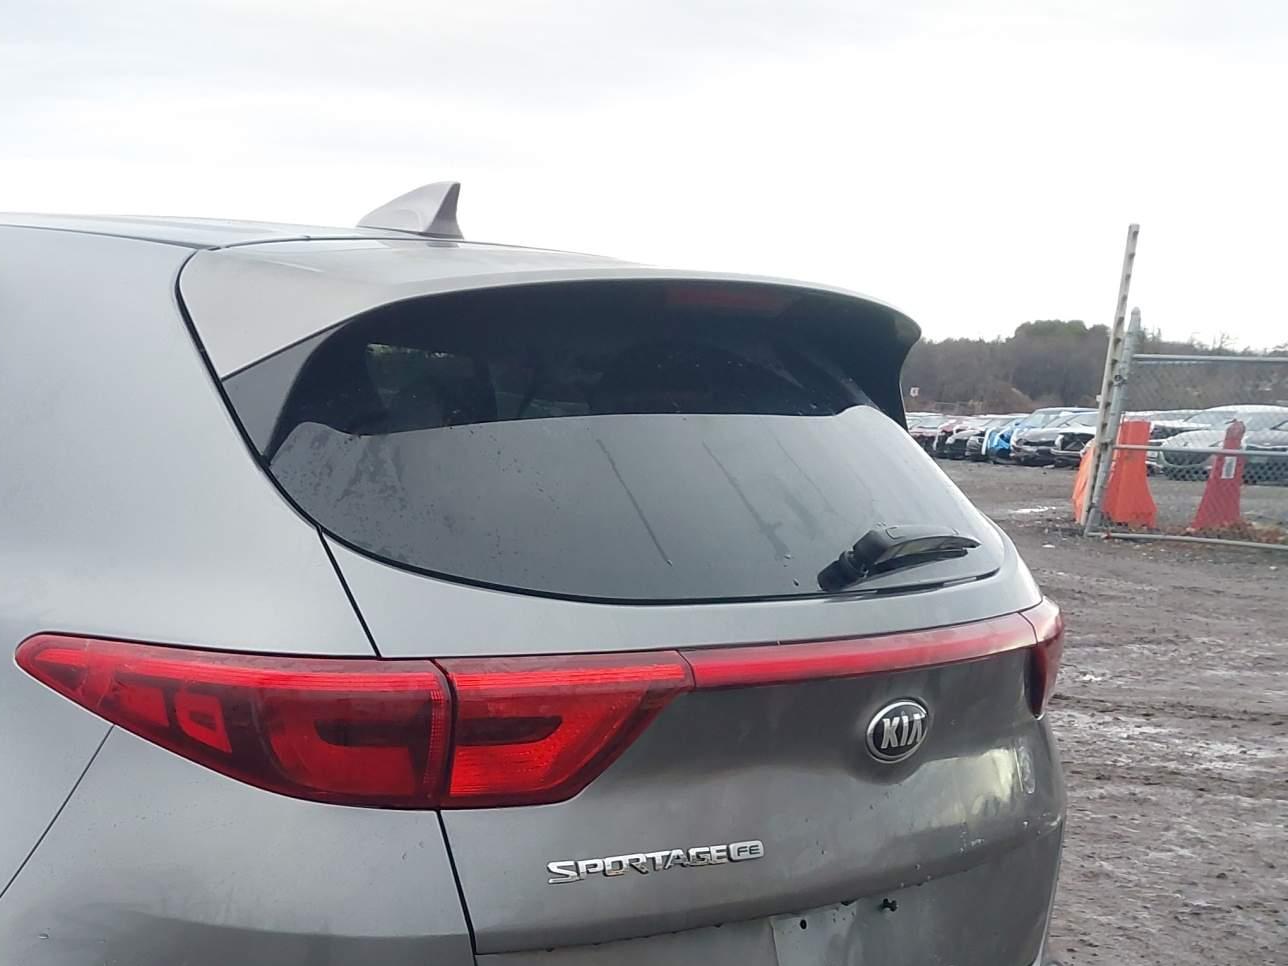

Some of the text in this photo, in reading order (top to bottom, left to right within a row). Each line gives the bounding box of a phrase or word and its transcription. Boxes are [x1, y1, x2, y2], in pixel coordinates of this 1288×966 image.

[880, 712, 928, 749] KIA
[546, 842, 762, 885] SPORTAGE FE
